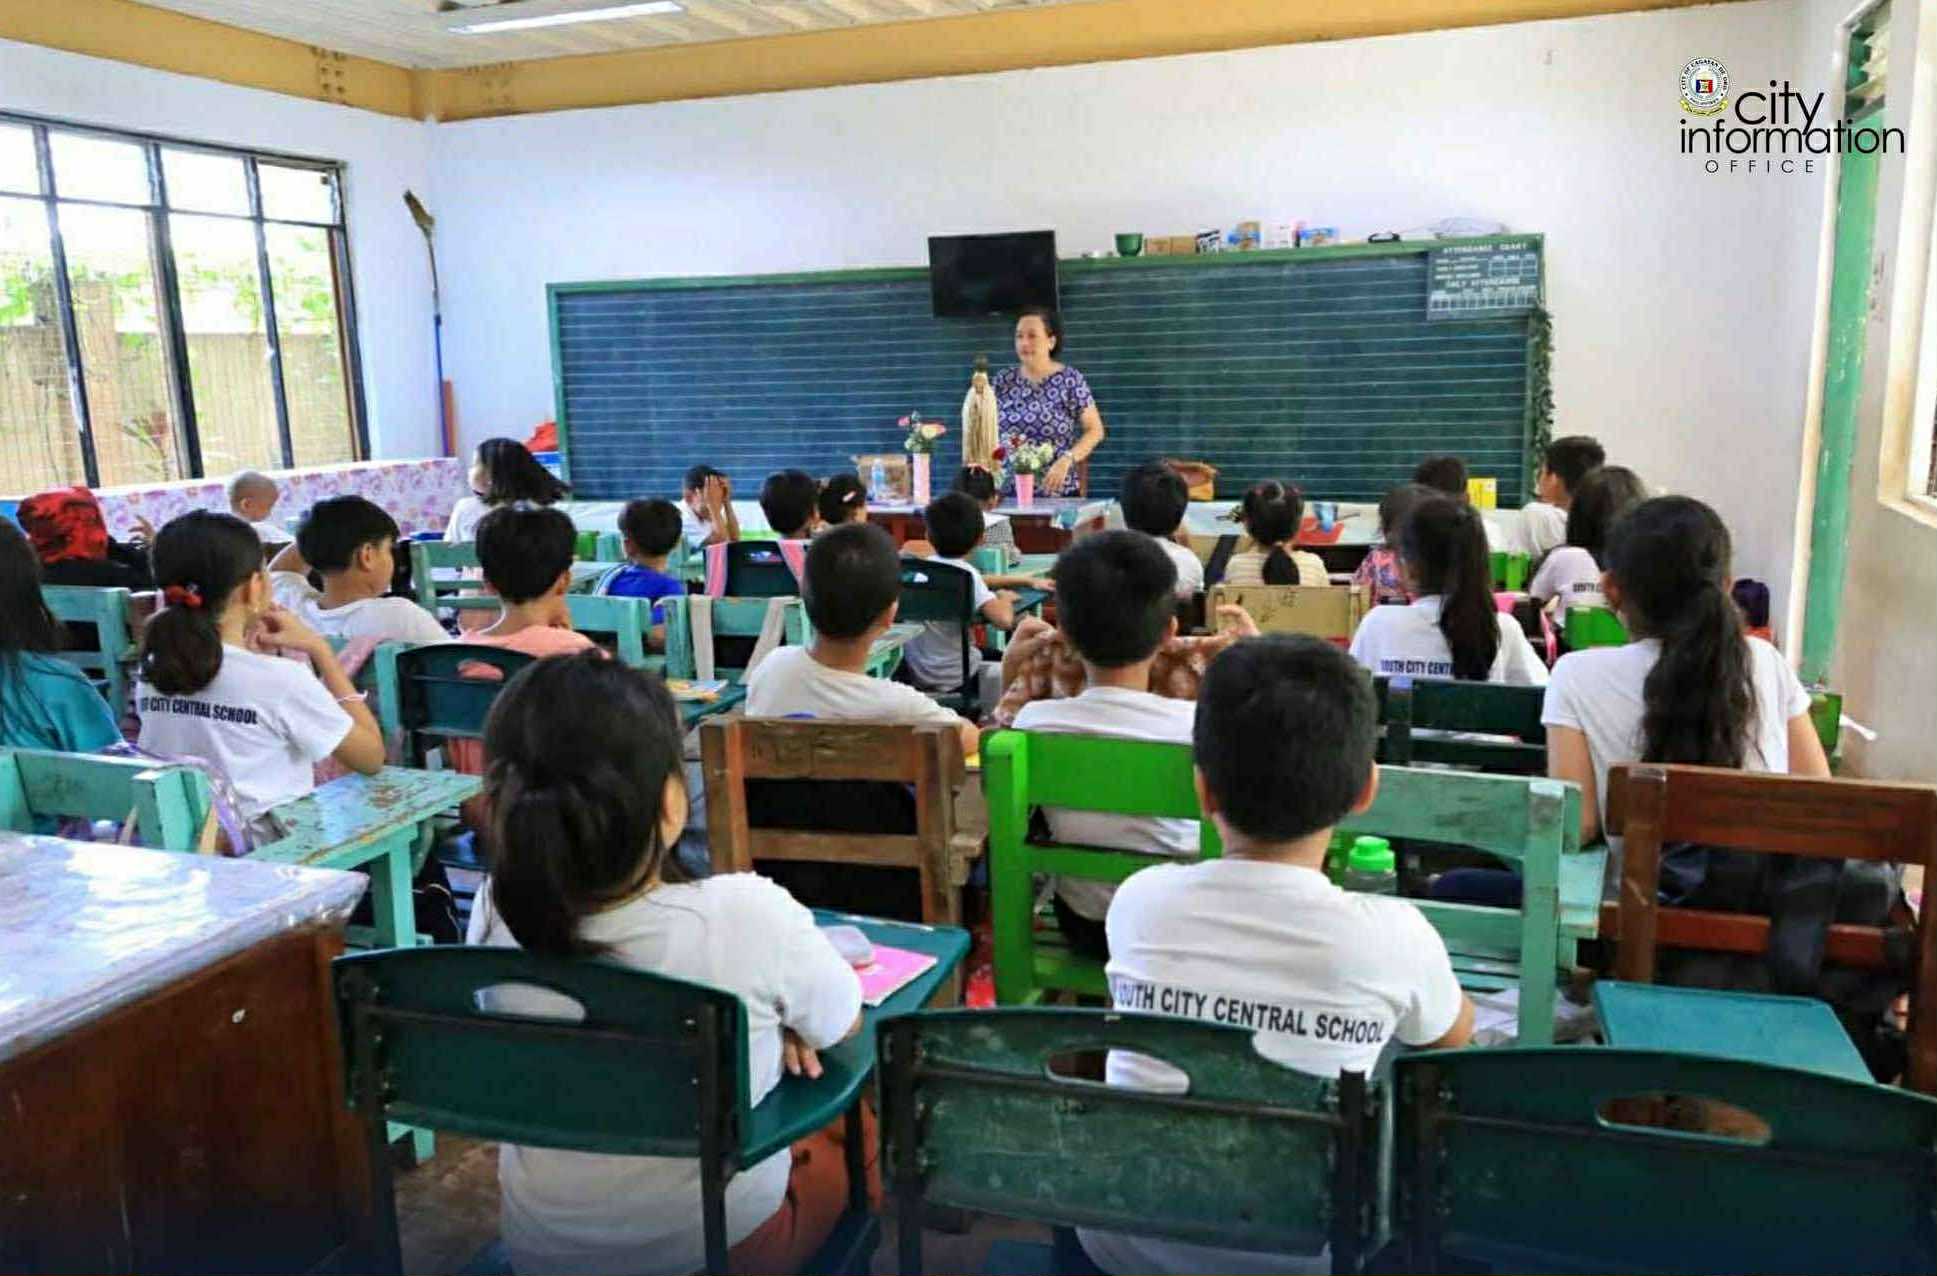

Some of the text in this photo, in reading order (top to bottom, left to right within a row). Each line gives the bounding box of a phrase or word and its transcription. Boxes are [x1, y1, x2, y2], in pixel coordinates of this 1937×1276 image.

[1406, 660, 1426, 674] CITY
[1427, 661, 1456, 675] CENT
[149, 696, 171, 713] CITY
[172, 699, 211, 718] CENTRAL
[212, 704, 258, 725] SCHOOL
[1117, 983, 1383, 1044] OUTH CITY CENTRAL SCHOOL
